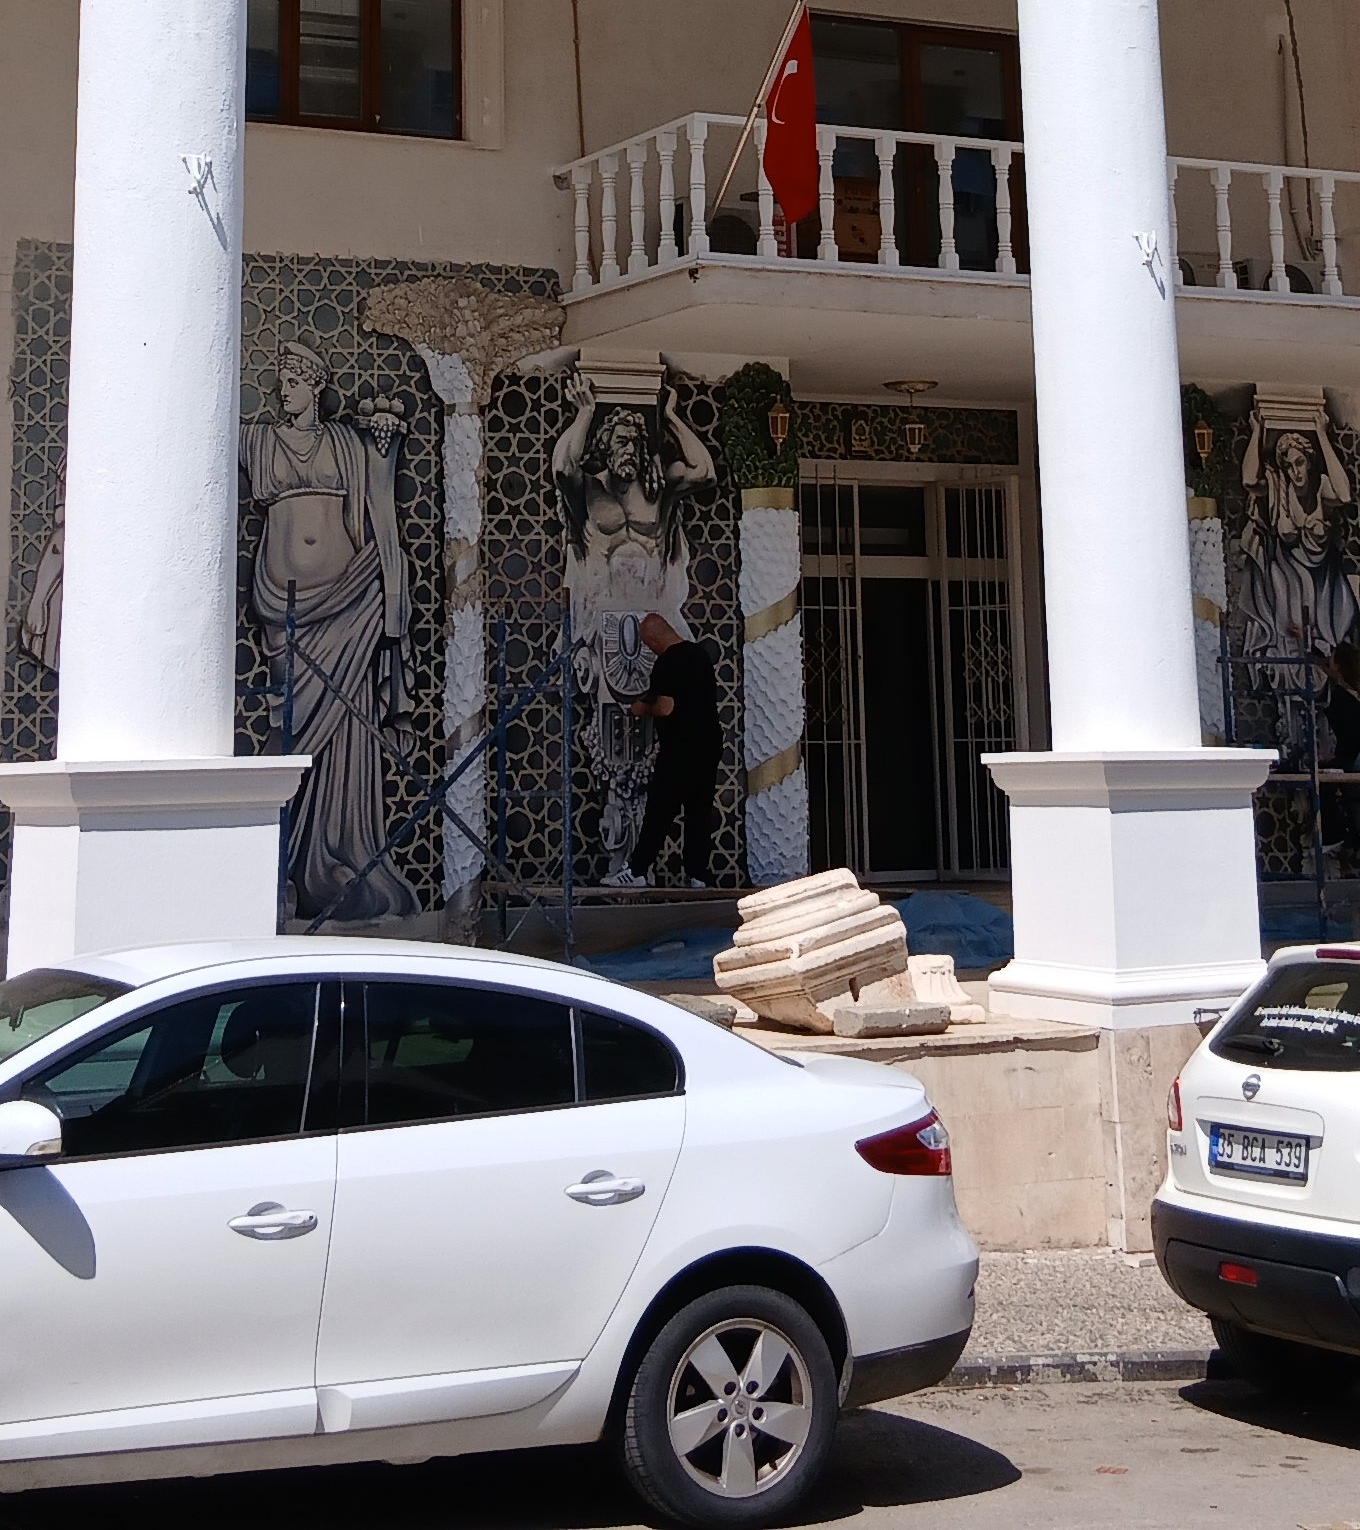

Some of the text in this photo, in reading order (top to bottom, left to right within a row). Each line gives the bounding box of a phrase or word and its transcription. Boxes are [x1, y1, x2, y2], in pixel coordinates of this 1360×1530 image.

[1217, 1132, 1235, 1159] 35
[1241, 1135, 1267, 1164] BCA
[1275, 1140, 1303, 1169] 539
